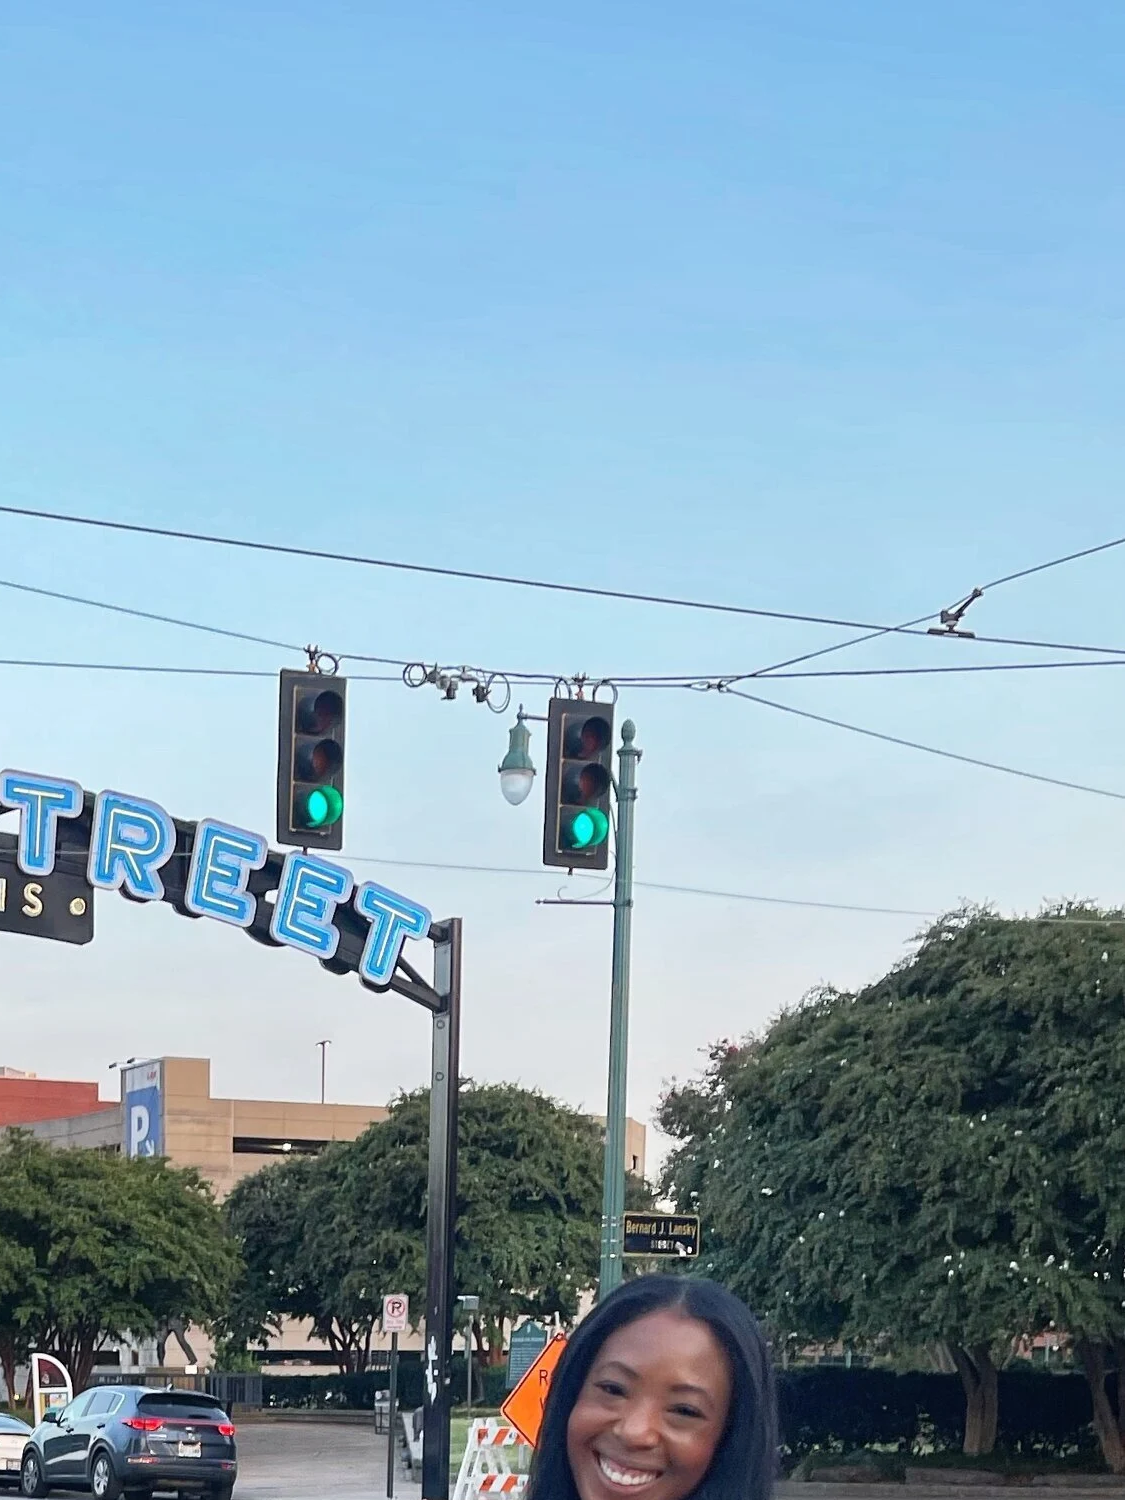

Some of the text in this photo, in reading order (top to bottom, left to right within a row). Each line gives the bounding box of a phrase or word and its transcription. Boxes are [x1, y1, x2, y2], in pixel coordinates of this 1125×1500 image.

[130, 1105, 150, 1160] P
[625, 1220, 657, 1235] Bernard
[668, 1221, 697, 1239] Lansky
